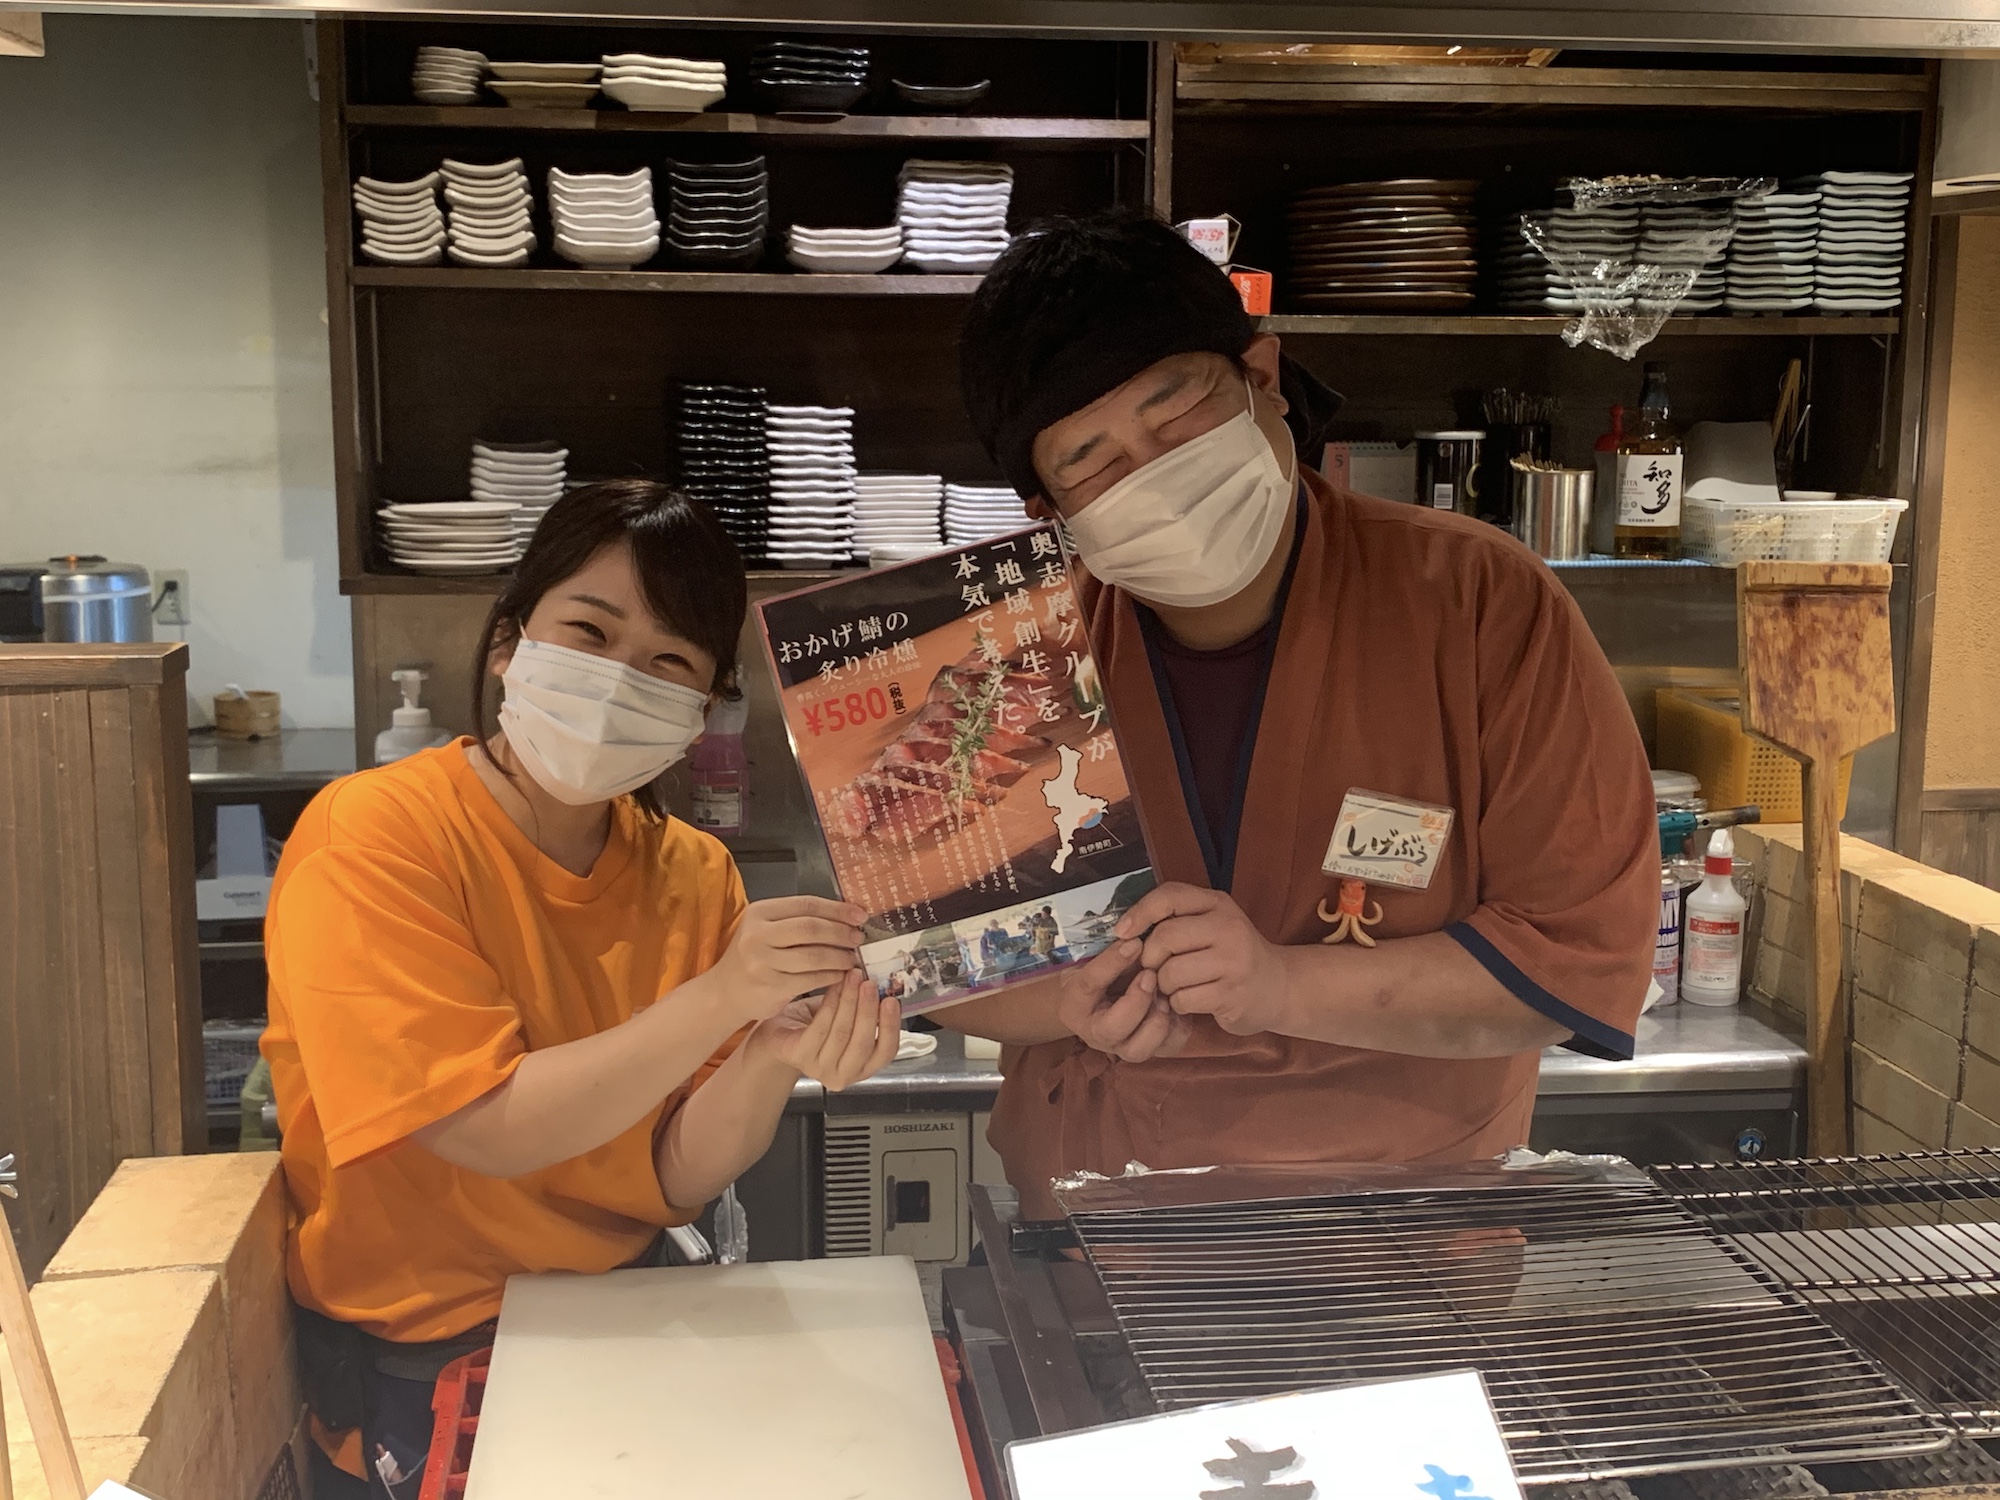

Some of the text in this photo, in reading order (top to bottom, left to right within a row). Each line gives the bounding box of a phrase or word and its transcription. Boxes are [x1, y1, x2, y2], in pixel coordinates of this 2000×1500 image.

[1641, 460, 1672, 514] 知多
[778, 611, 909, 664] おかげ鯖の
[951, 553, 1026, 735] 本気で考えた。
[990, 540, 1061, 723] 「地域創生」を
[1030, 531, 1115, 763] 奥志摩グループが
[801, 687, 888, 737] ¥580
[883, 1122, 955, 1134] HOSHIZAKI
